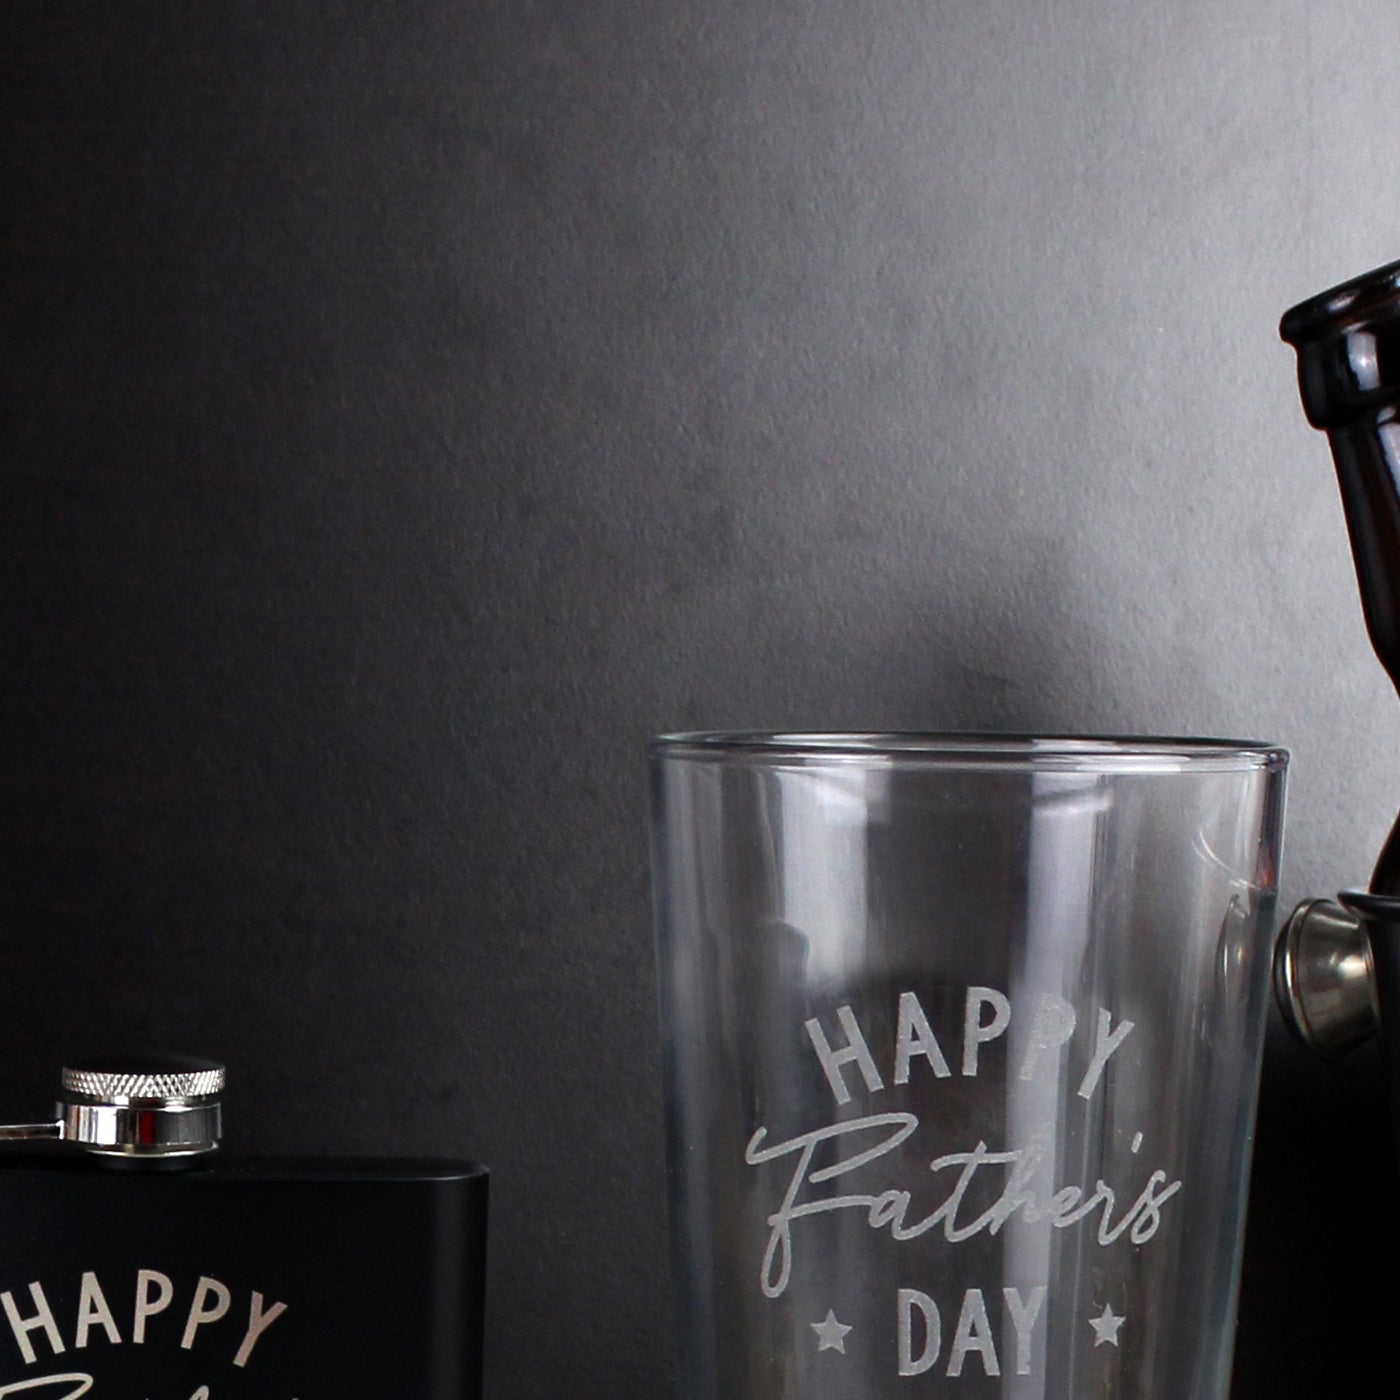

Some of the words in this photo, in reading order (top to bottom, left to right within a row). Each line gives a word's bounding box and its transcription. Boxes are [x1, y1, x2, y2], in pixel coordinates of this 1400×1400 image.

[805, 986, 1135, 1105] HAPPY
[745, 1112, 1181, 1298] Father's
[0, 1269, 288, 1368] HAPPY
[898, 1288, 1046, 1377] DAY
